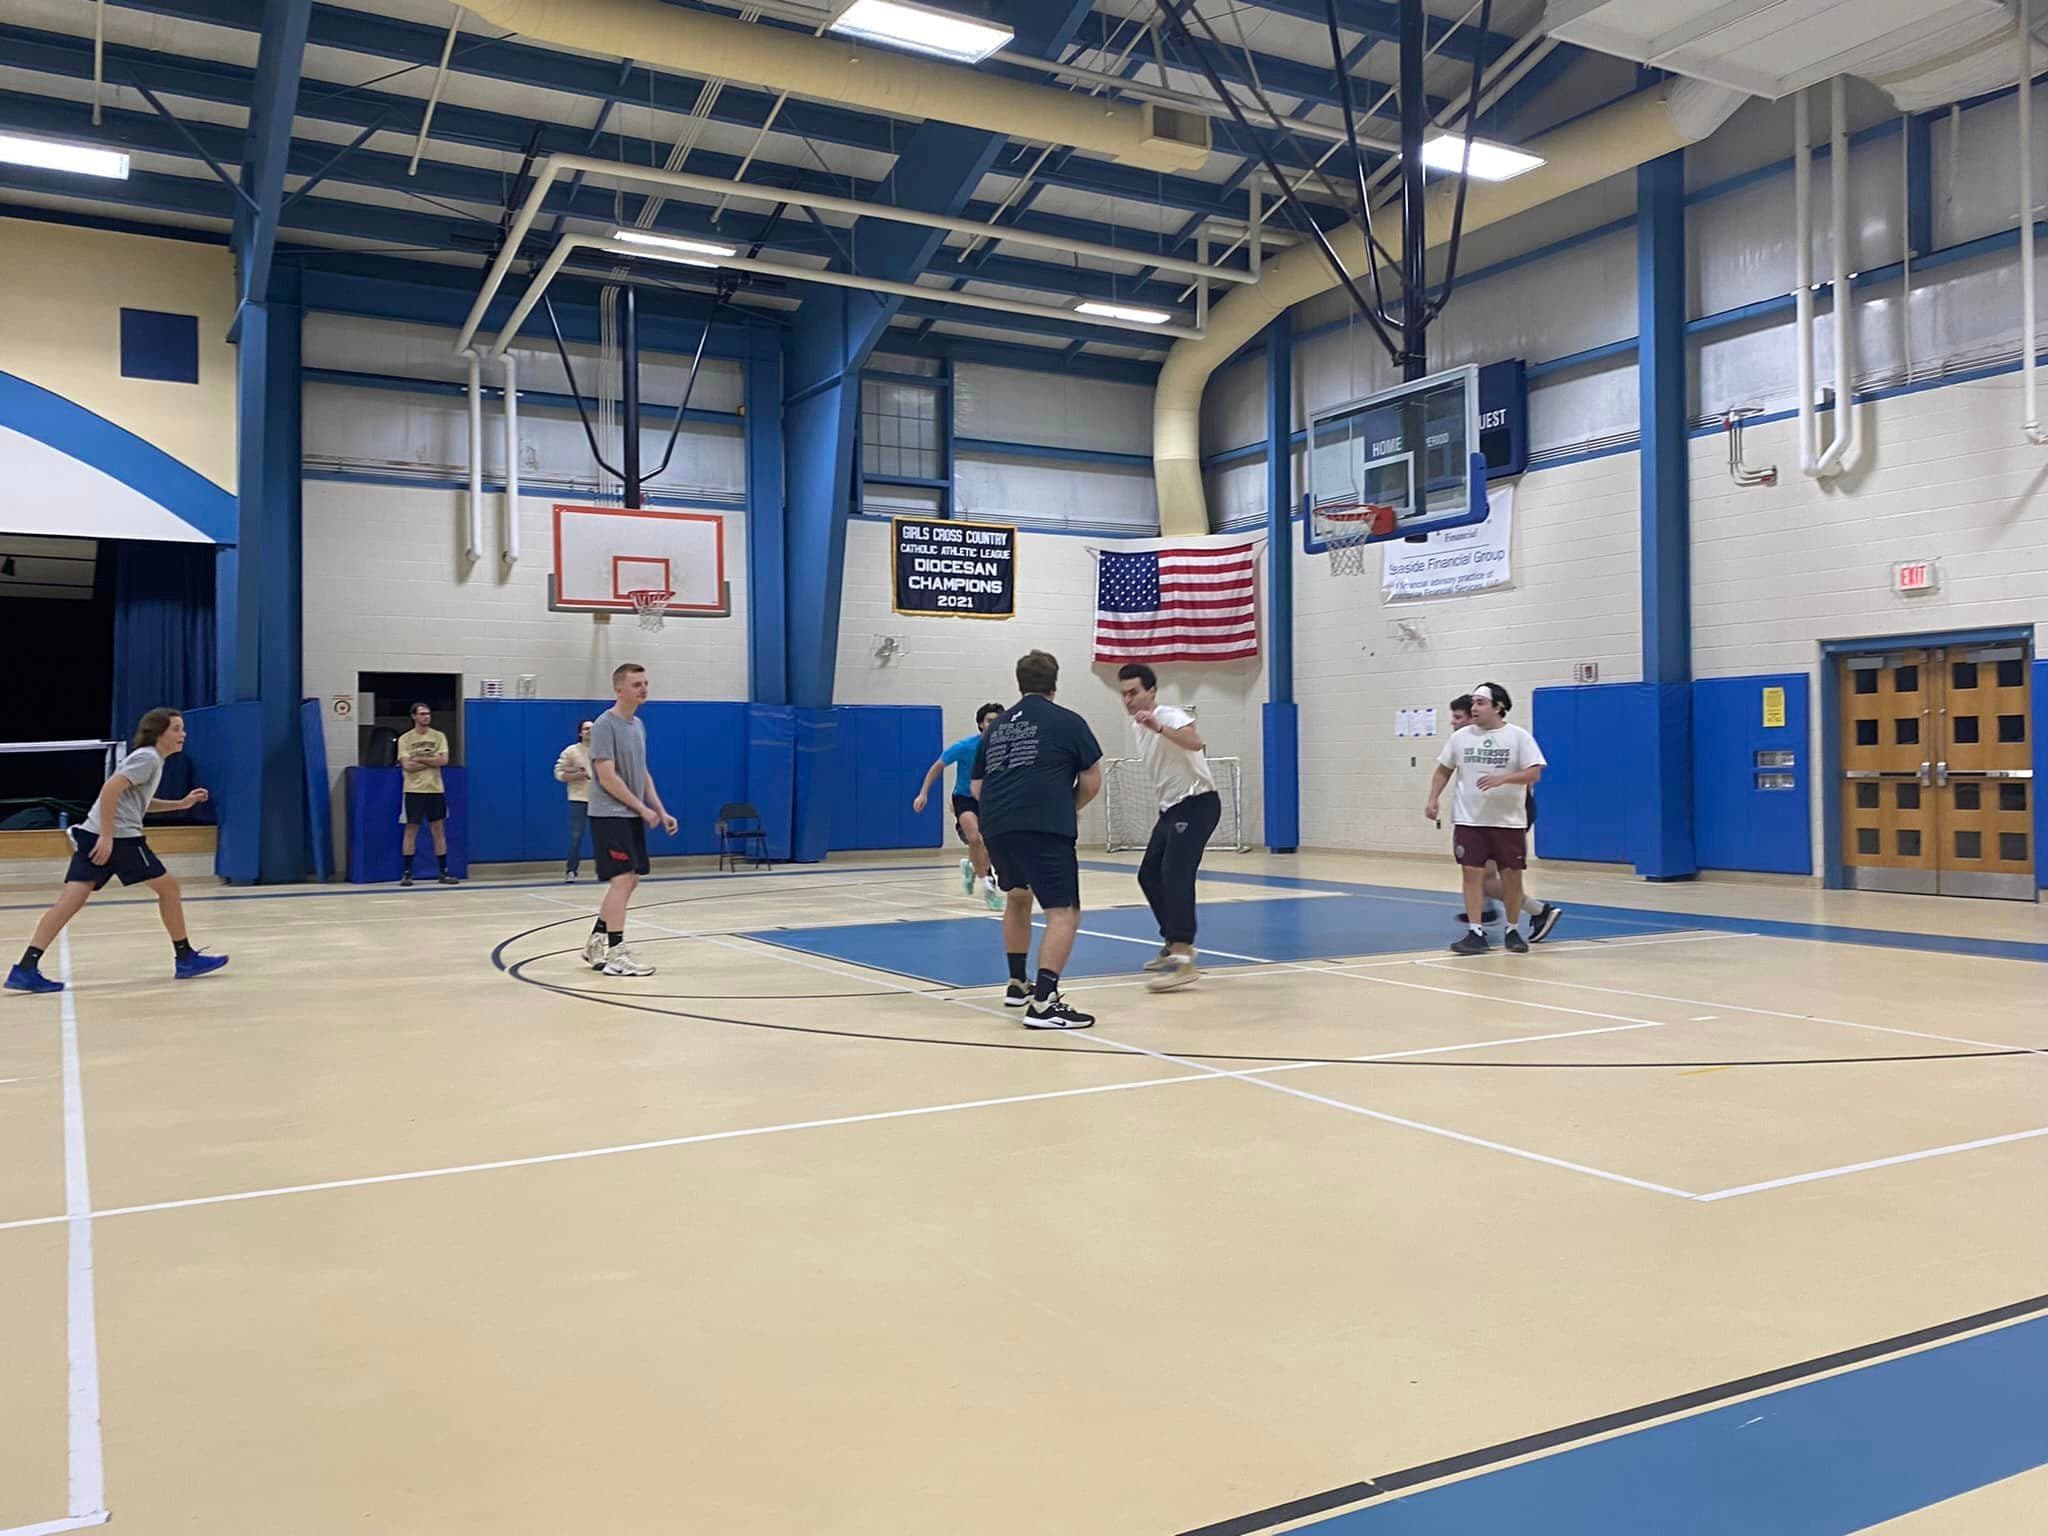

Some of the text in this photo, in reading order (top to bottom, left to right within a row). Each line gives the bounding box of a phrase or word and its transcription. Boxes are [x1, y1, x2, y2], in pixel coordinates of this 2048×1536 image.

[1479, 409, 1506, 430] UEST
[1372, 436, 1402, 457] HOME
[1425, 432, 1449, 447] ERIOD
[902, 526, 1007, 546] GIRLS CROSS COUNTRY
[900, 543, 1011, 560] CATHOLIC ATHLETIC LEAGUE
[1427, 552, 1471, 570] Financial
[1473, 549, 1505, 564] Group
[914, 558, 998, 576] DIOCESAN
[1900, 565, 1926, 586] EXIT
[908, 575, 1003, 594] CHAMPIONS
[937, 595, 974, 608] 2021
